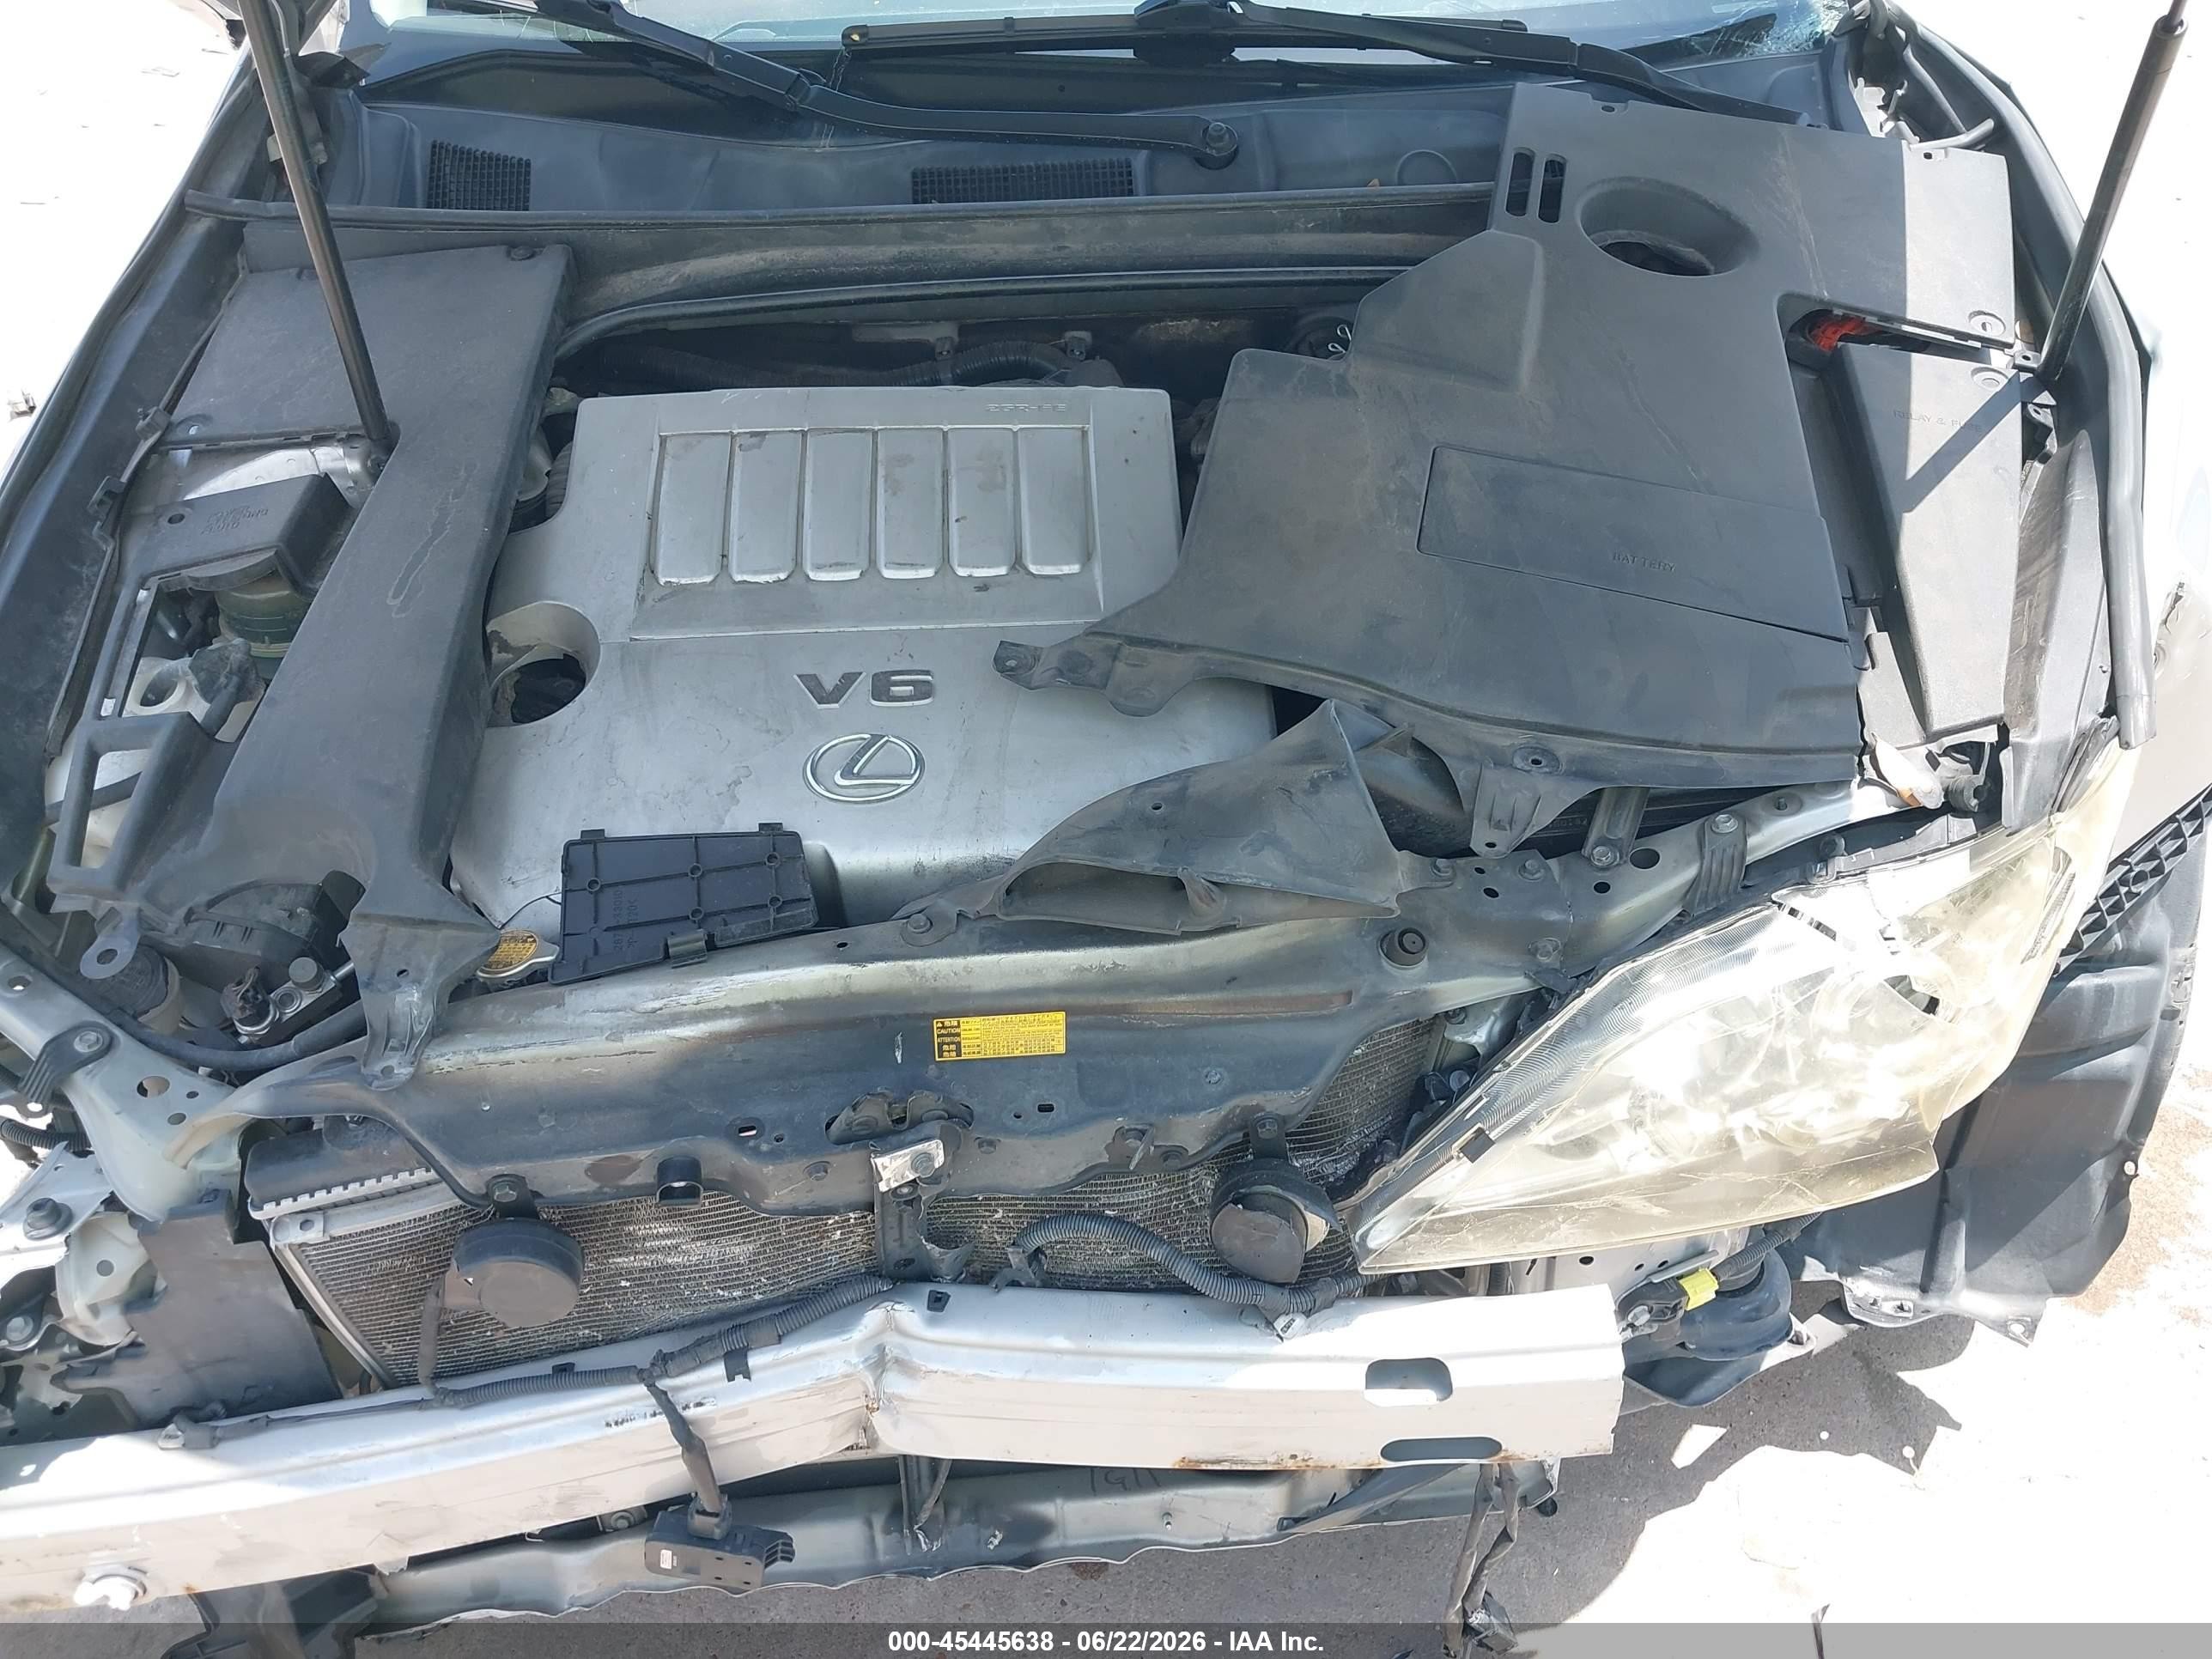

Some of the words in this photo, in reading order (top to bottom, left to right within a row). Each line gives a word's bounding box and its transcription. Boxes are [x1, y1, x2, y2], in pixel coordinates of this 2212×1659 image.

[1893, 410, 1932, 424] RELAY
[1936, 417, 1946, 426] &
[1613, 550, 1676, 571] BATTERY
[793, 669, 933, 709] V6
